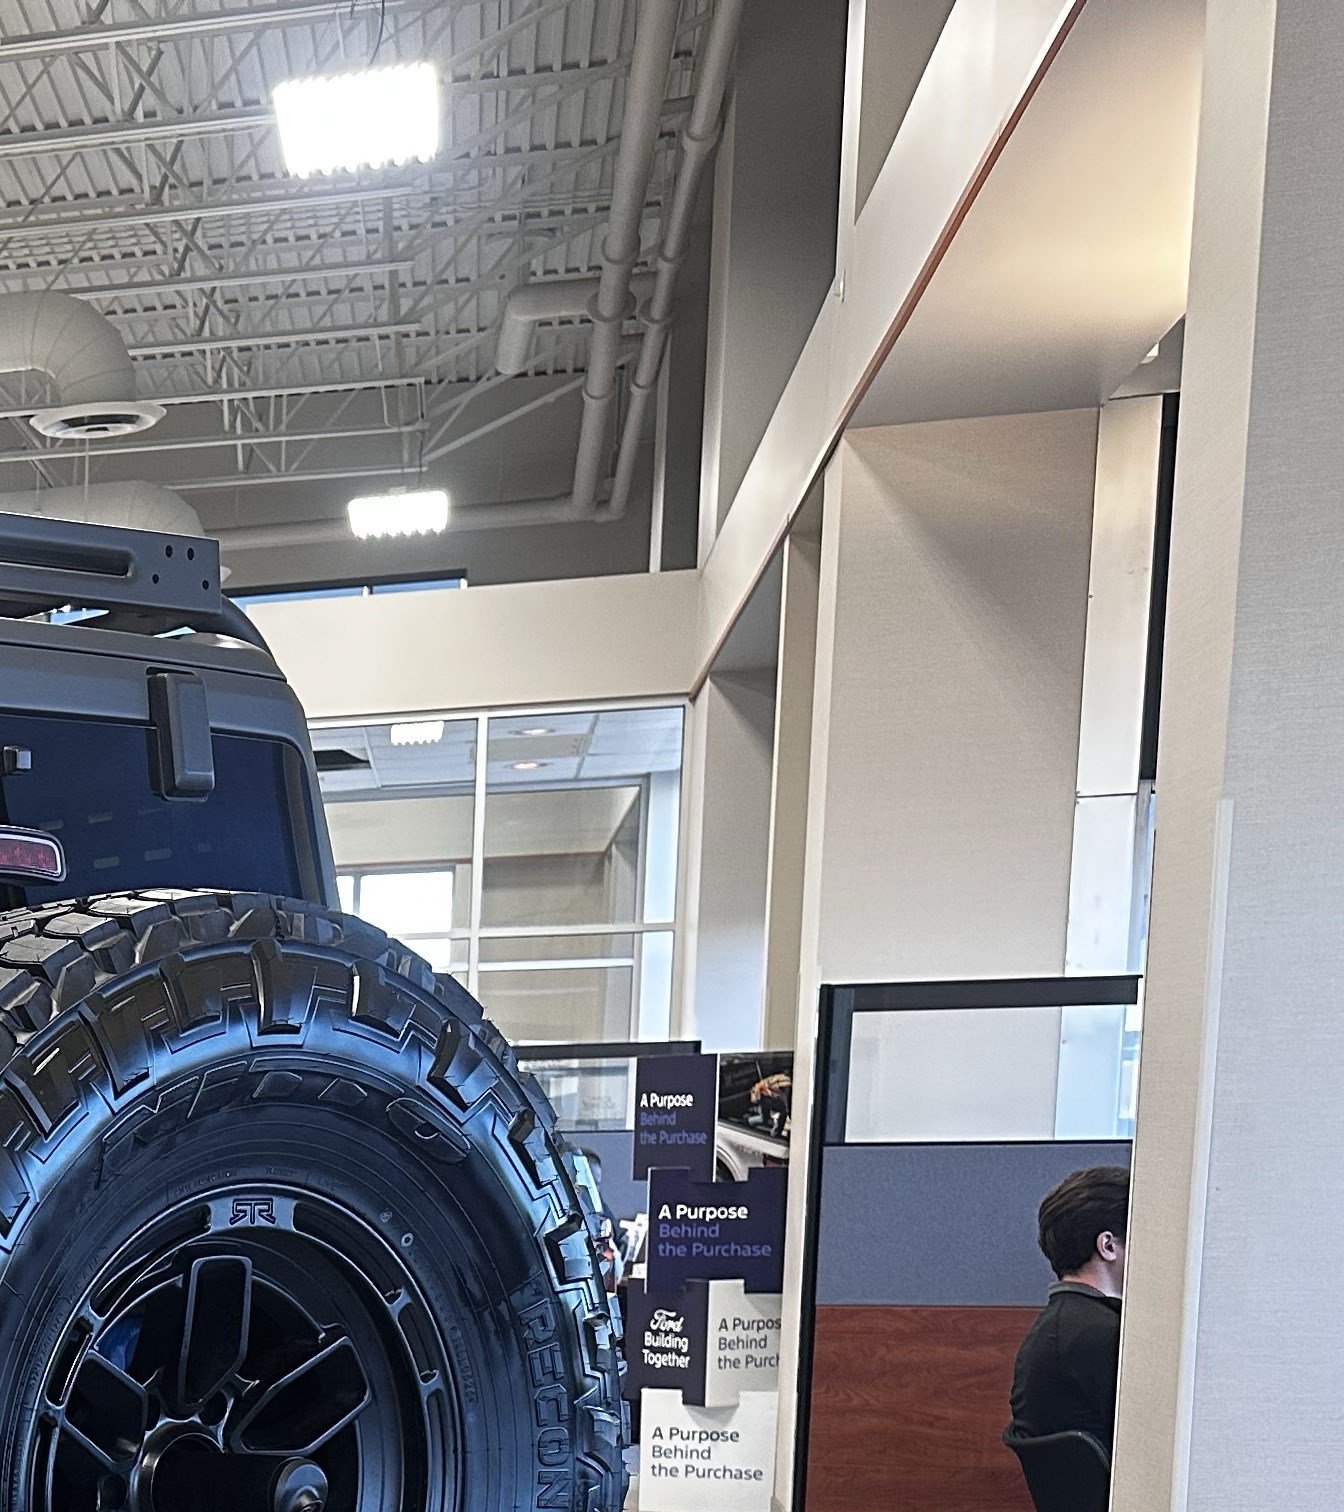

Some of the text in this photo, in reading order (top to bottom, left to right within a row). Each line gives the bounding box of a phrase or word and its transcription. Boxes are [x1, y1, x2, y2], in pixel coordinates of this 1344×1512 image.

[640, 1093, 694, 1109] A Purpose
[640, 1112, 677, 1126] Behind
[640, 1130, 707, 1145] the Purchase
[658, 1204, 748, 1222] A Purpose
[658, 1223, 720, 1239] Behind
[658, 1242, 772, 1257] the Purchase
[650, 1308, 684, 1333] Ford
[718, 1317, 782, 1333] A Purpos
[644, 1332, 689, 1352] Building
[718, 1335, 768, 1350] Behind
[642, 1349, 690, 1369] Together
[717, 1355, 741, 1370] the
[518, 1298, 570, 1509] RECON
[652, 1426, 740, 1444] A Purpose
[652, 1445, 712, 1460] Behind
[651, 1464, 764, 1481] the Purchase
